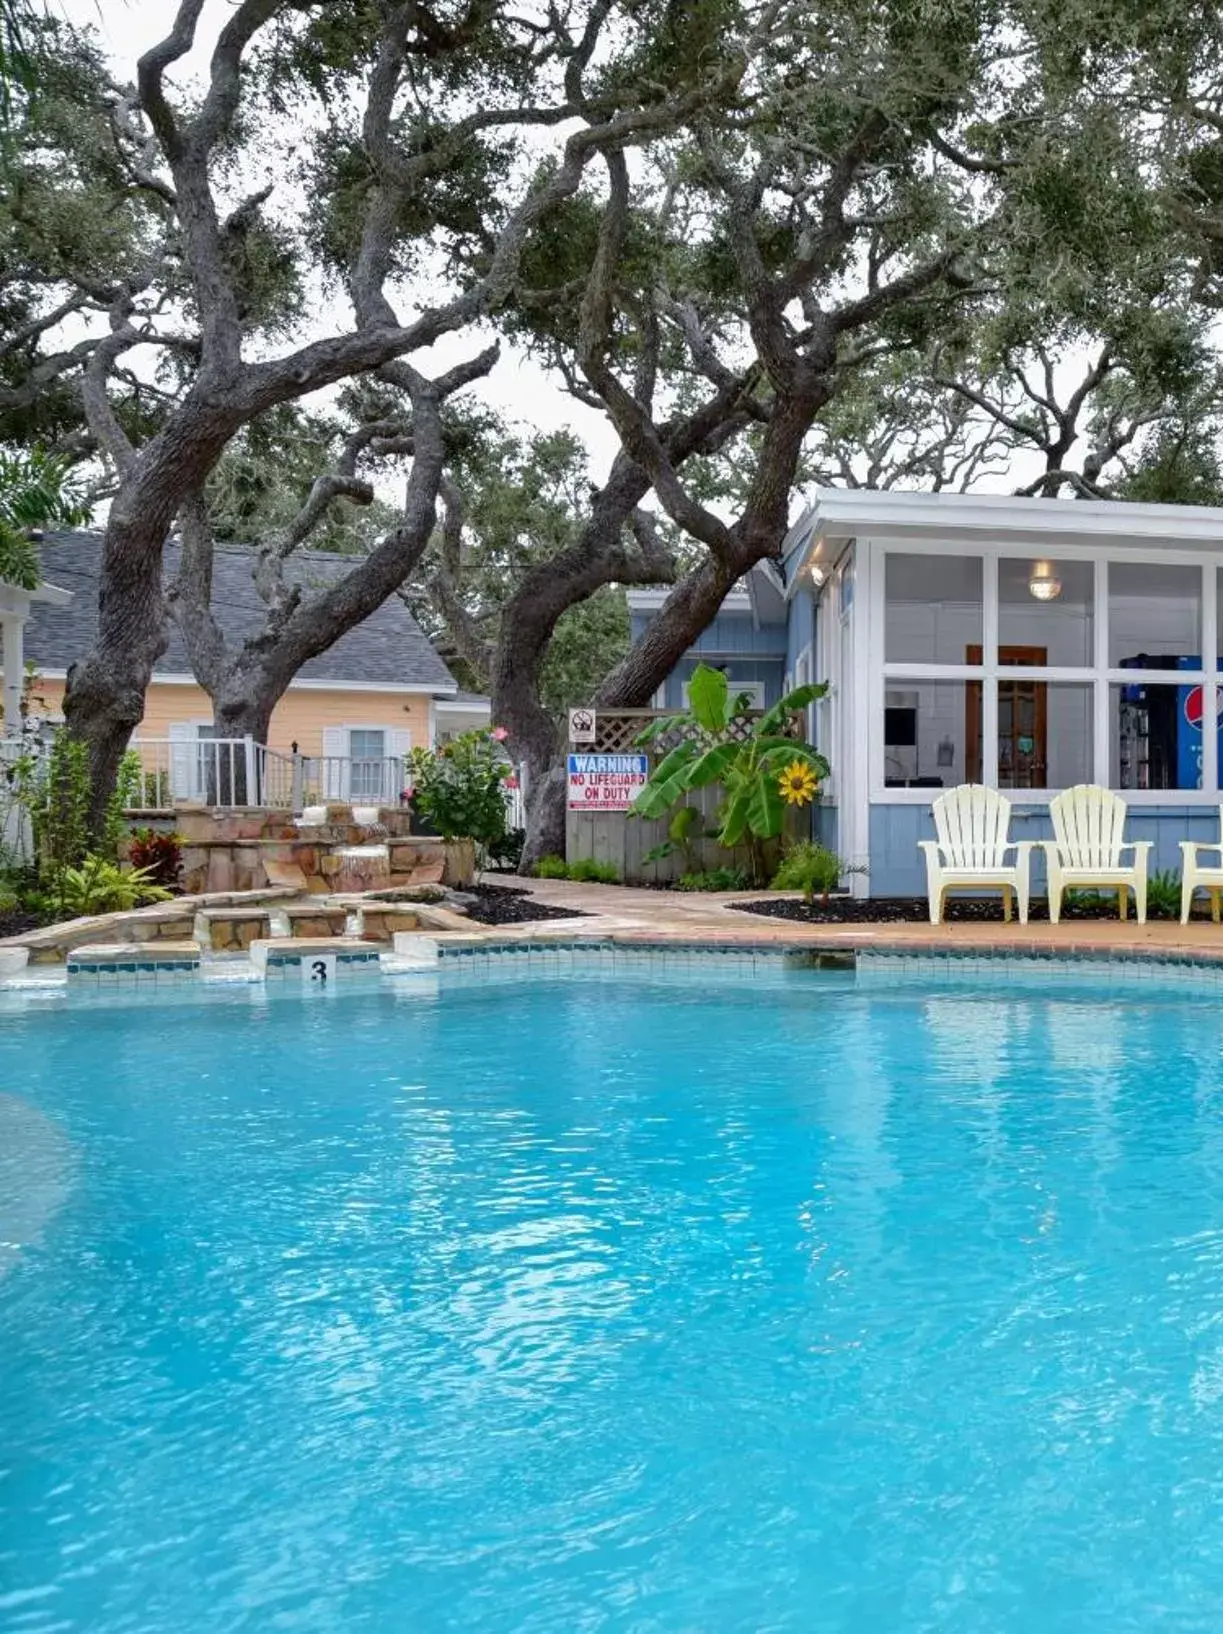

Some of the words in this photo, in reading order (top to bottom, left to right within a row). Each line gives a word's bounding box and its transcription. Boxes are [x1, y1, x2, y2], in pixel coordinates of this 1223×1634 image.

[575, 756, 642, 773] WARNING
[570, 774, 585, 786] NO
[589, 774, 645, 786] LIFEGUARD
[584, 787, 599, 800] ON
[603, 787, 630, 800] DUTY
[311, 961, 327, 981] 3
